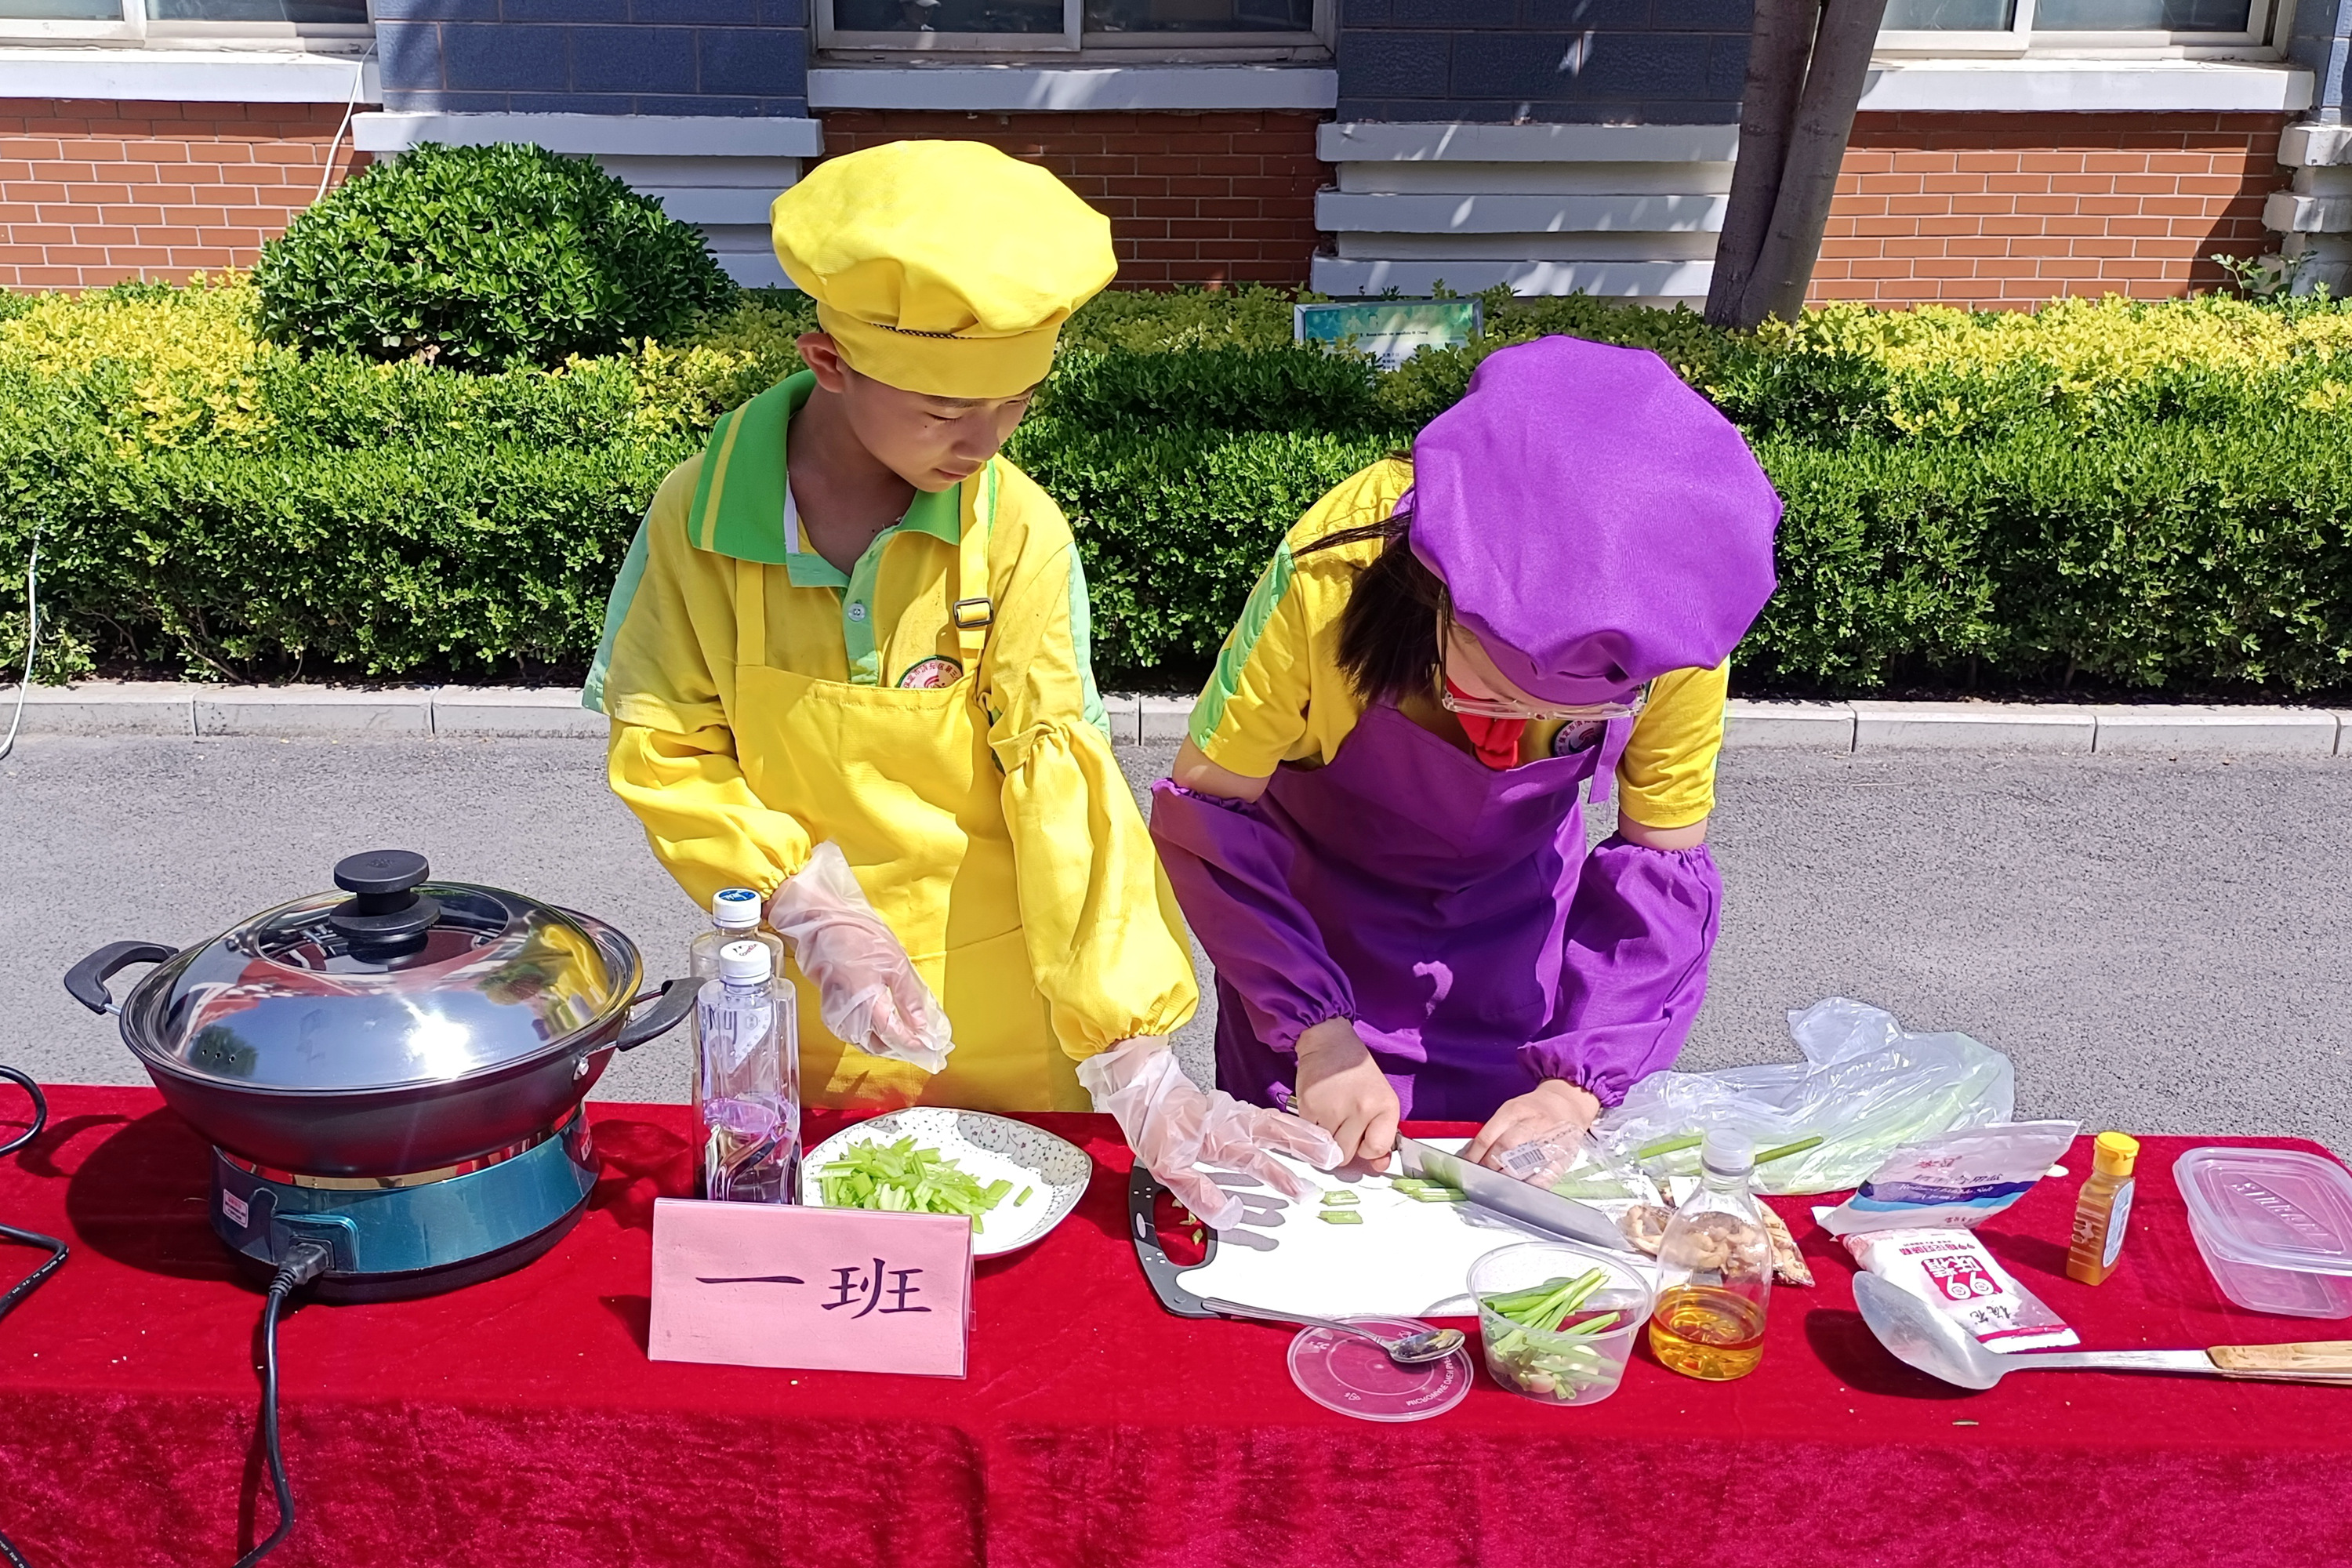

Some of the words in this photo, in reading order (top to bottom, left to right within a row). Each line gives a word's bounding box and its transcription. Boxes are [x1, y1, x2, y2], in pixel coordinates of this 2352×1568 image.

[1924, 1255, 1984, 1279] 味精
[695, 1257, 932, 1319] 一班
[1946, 1269, 1995, 1301] 99
